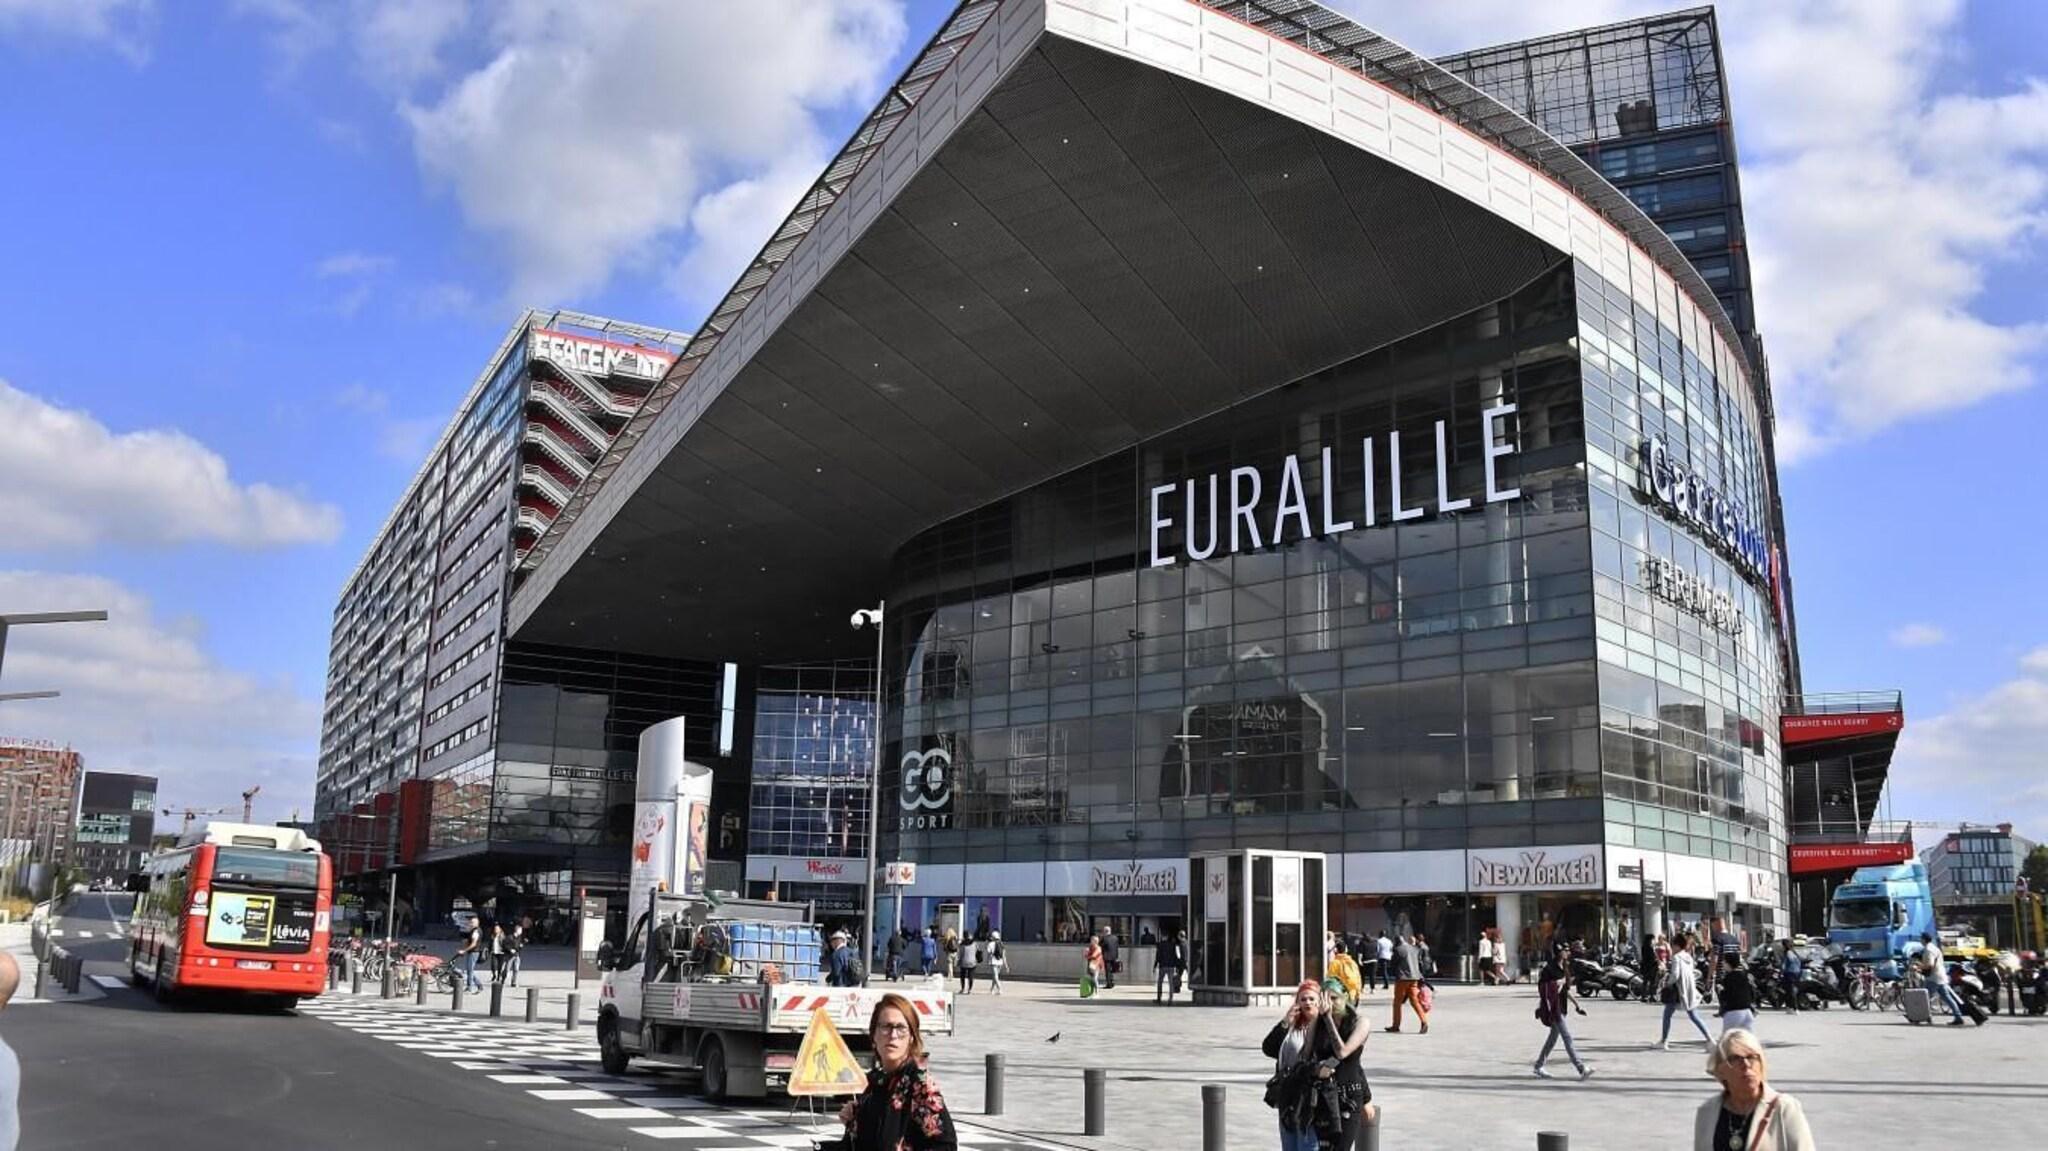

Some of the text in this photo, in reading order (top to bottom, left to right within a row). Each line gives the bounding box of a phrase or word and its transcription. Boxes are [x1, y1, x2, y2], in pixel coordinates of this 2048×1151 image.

[1150, 403, 1521, 568] EURALILLE
[901, 748, 952, 811] GO
[900, 813, 947, 830] SPORT
